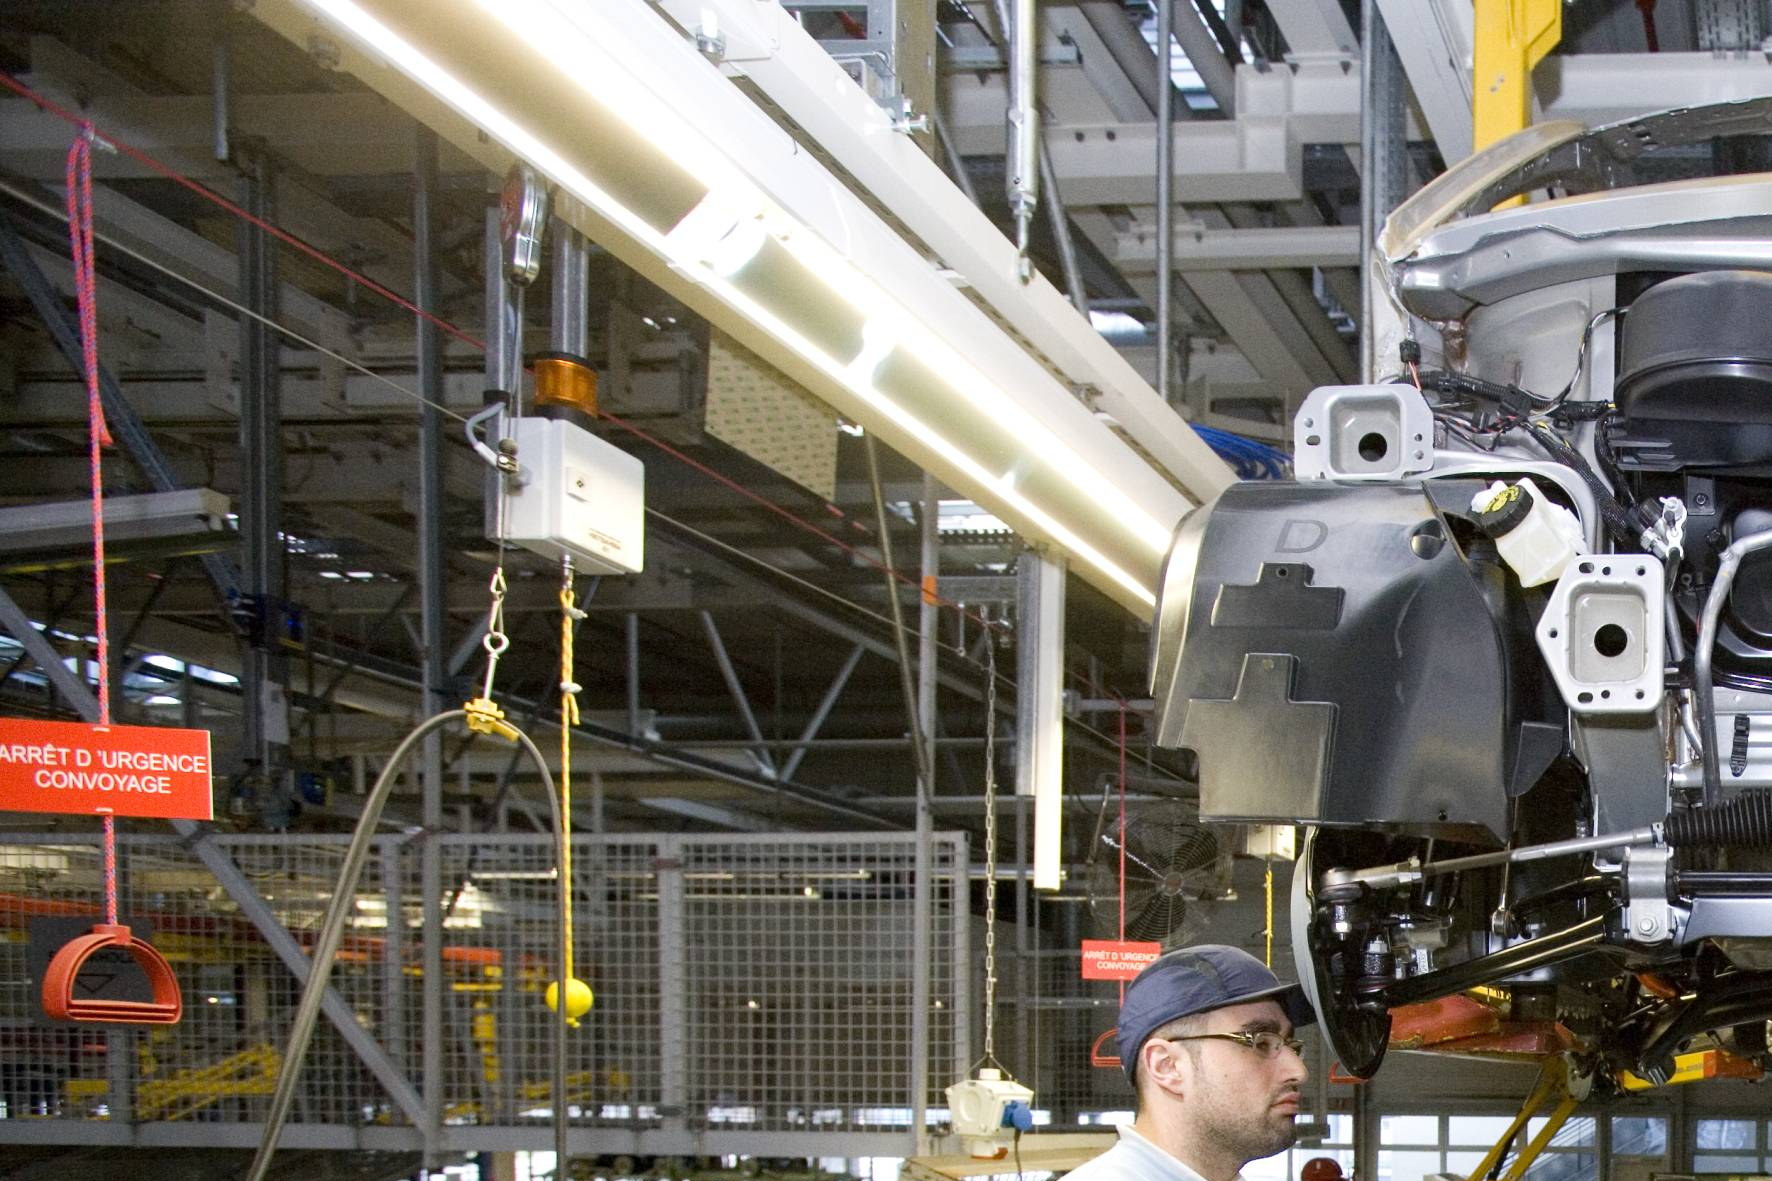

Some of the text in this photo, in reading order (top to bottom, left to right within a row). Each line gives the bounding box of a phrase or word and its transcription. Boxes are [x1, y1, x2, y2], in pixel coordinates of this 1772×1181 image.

[1274, 519, 1329, 553] D
[0, 744, 70, 766] ARRÊT
[34, 770, 171, 794] CONVOYAGE
